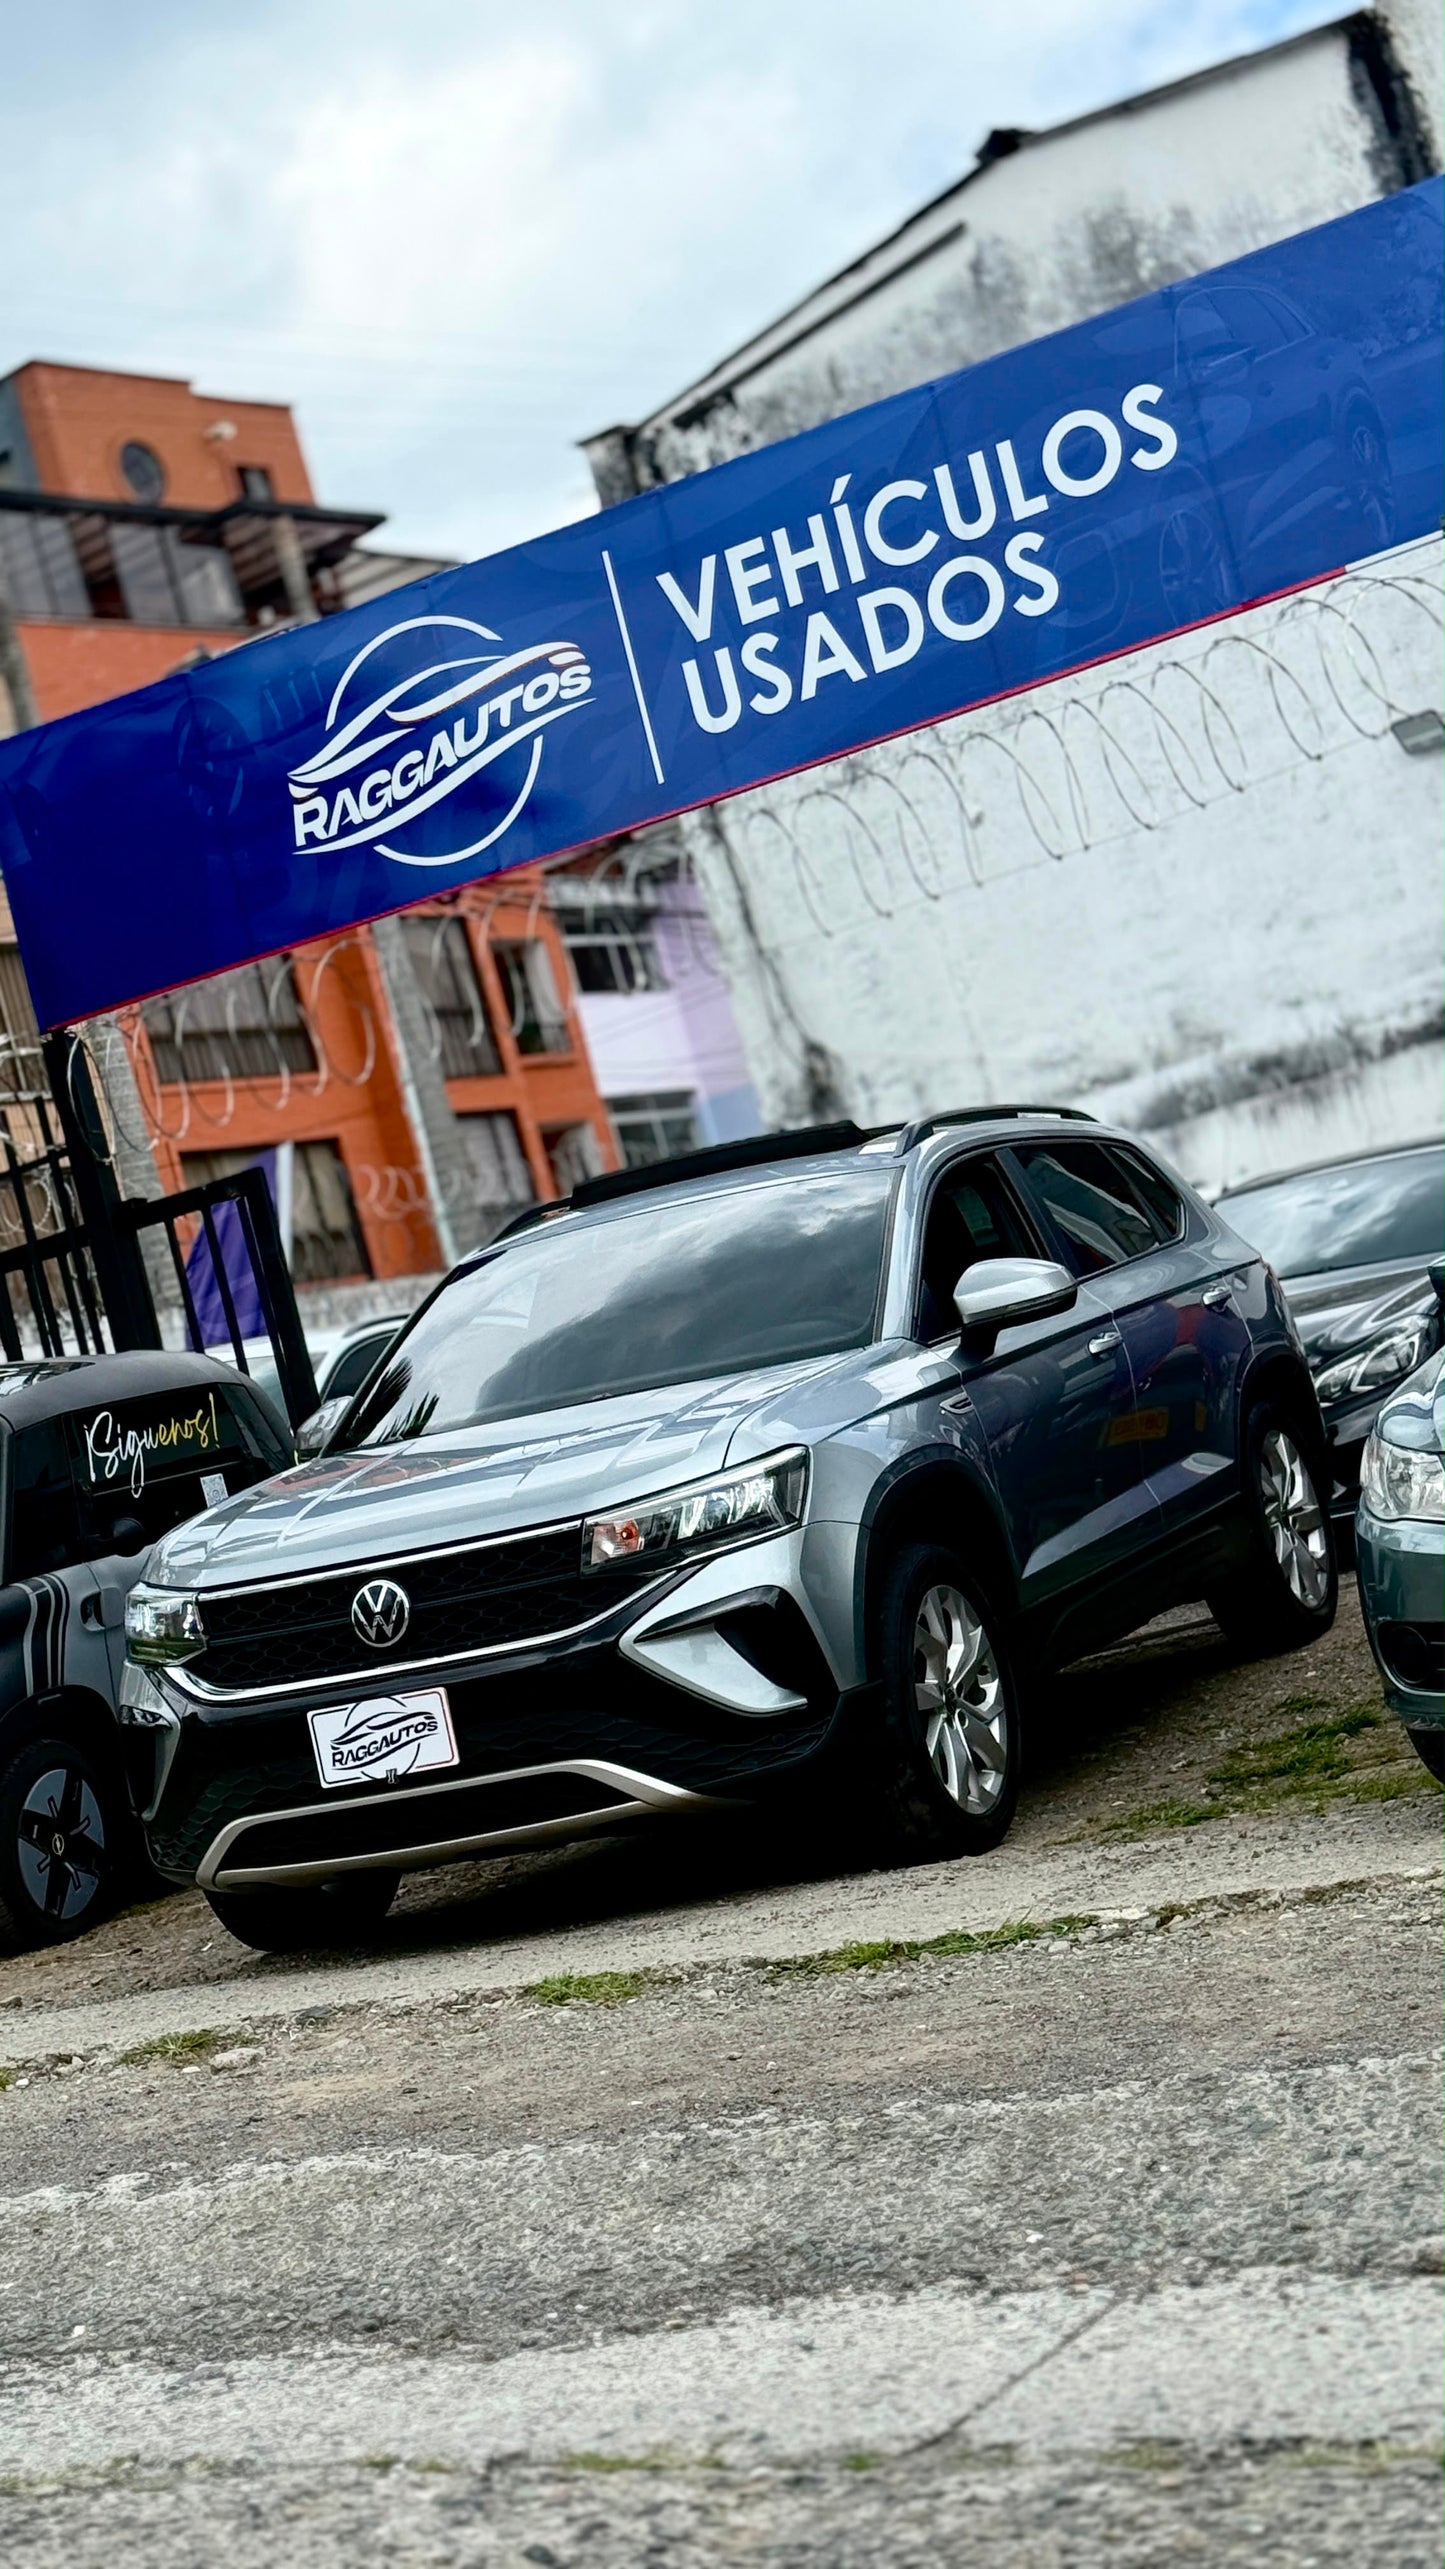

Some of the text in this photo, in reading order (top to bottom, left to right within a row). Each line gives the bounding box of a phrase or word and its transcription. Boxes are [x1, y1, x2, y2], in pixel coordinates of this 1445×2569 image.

[656, 384, 1177, 642] VEHÍCULOS
[682, 532, 1058, 733] USADOS
[293, 664, 592, 847] RAGGAUTOS
[332, 1720, 438, 1767] RAGGAUTOS
